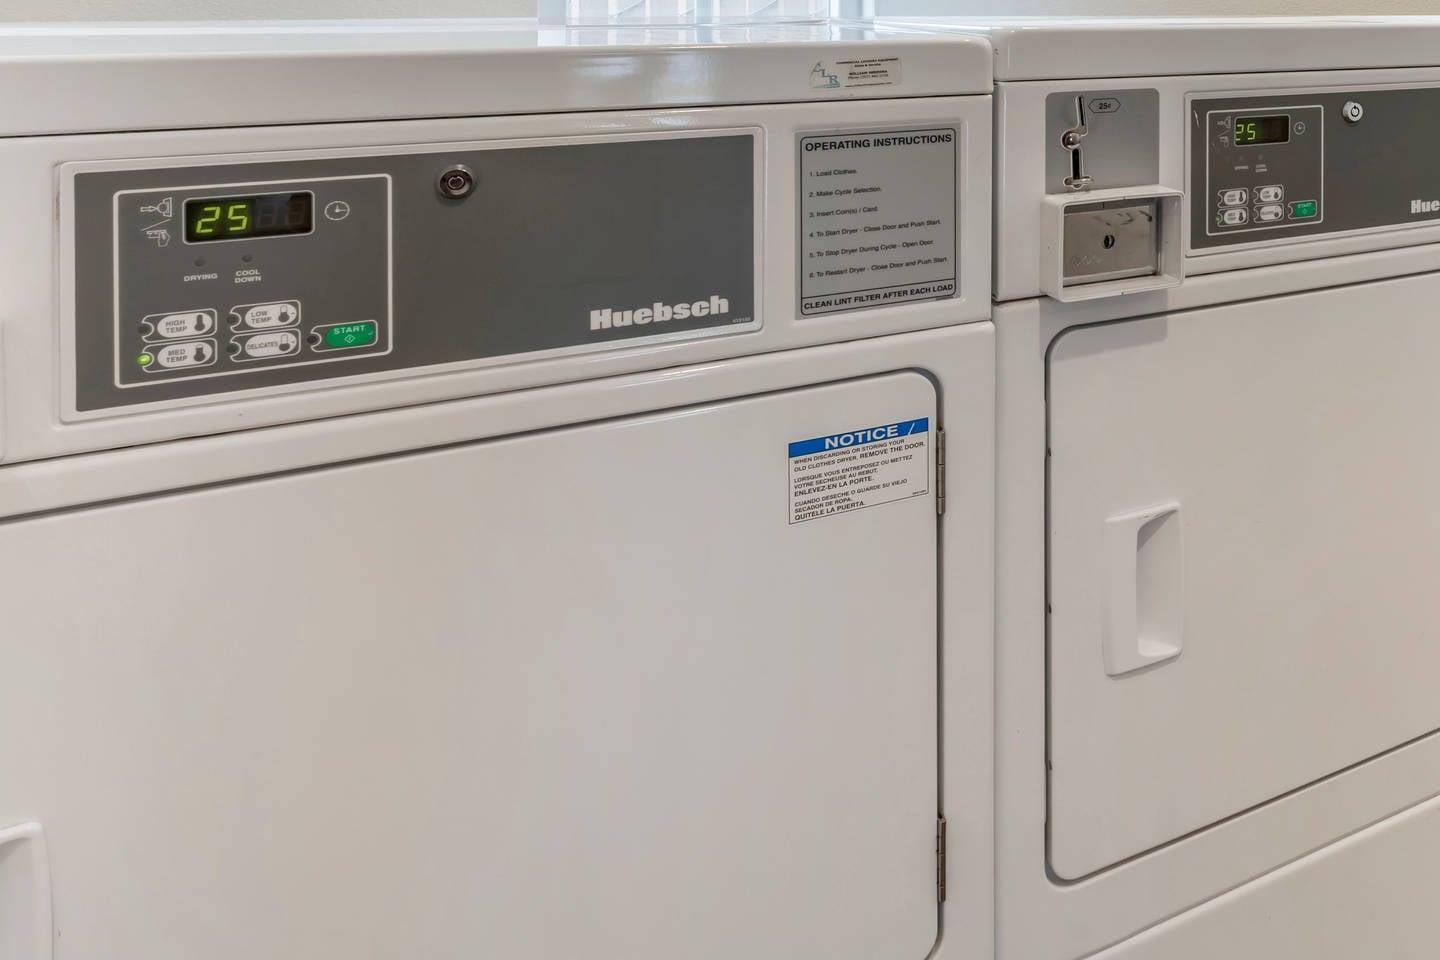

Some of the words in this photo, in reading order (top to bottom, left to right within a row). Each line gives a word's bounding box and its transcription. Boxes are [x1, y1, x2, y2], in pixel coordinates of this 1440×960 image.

[805, 139, 870, 151] OPERATING
[873, 134, 952, 147] INSTRUCTIONS
[196, 204, 248, 234] 25
[184, 273, 218, 282] DRYING
[804, 300, 832, 310] CLEAN
[834, 297, 852, 305] LINT
[854, 294, 881, 302] FILTER
[883, 290, 908, 299] AFTER
[933, 284, 953, 292] LOAD
[590, 295, 729, 330] Huebsch
[165, 319, 186, 327] HIGH
[251, 316, 272, 324] TEMP
[166, 326, 188, 334] TEMP
[334, 325, 365, 335] START
[247, 341, 279, 350] DELICATES
[166, 355, 188, 363] TEMP
[825, 425, 898, 449] NOTICE
[808, 460, 835, 469] CLOTHES
[860, 448, 888, 459] REMOVE
[814, 450, 850, 460] DISCARDING
[862, 443, 887, 451] STORING
[794, 473, 822, 483] LORSQUE
[842, 461, 880, 473] ENTREPOSEZ
[794, 481, 814, 490] VOTRE
[816, 475, 847, 485] SECHEUSE
[794, 484, 837, 497] ENLEVEZ-EN
[795, 498, 820, 507] CUANDO
[822, 491, 849, 501] DESECHE
[857, 485, 881, 493] GUARDE
[795, 504, 824, 513] SECADOR
[795, 511, 824, 520] QUITELE
